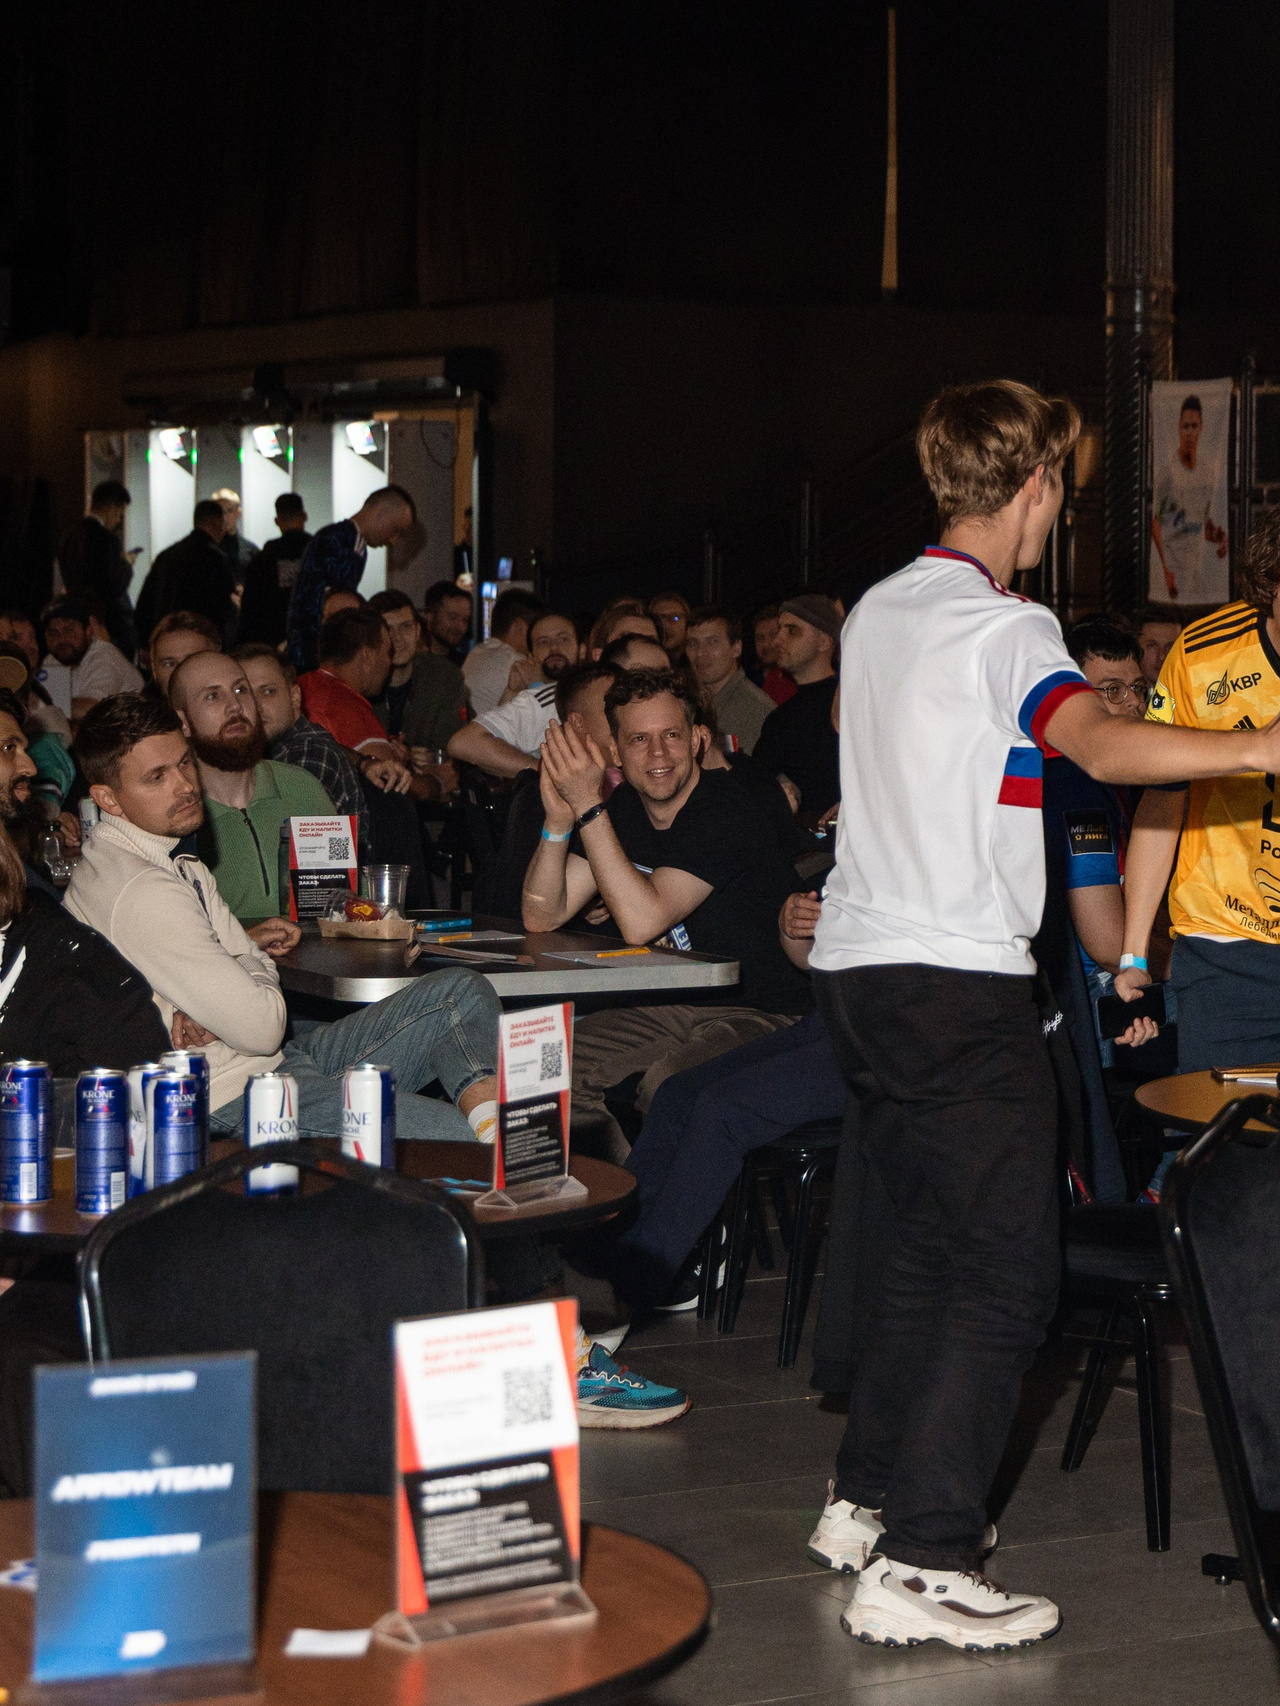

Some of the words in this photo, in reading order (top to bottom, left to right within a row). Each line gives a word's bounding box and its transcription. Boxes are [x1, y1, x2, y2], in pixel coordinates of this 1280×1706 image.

[0, 1081, 23, 1091] RONE
[83, 1090, 115, 1099] KRONE
[166, 1093, 197, 1103] KRONE
[343, 1112, 371, 1126] ONE
[257, 1120, 299, 1135] KRON
